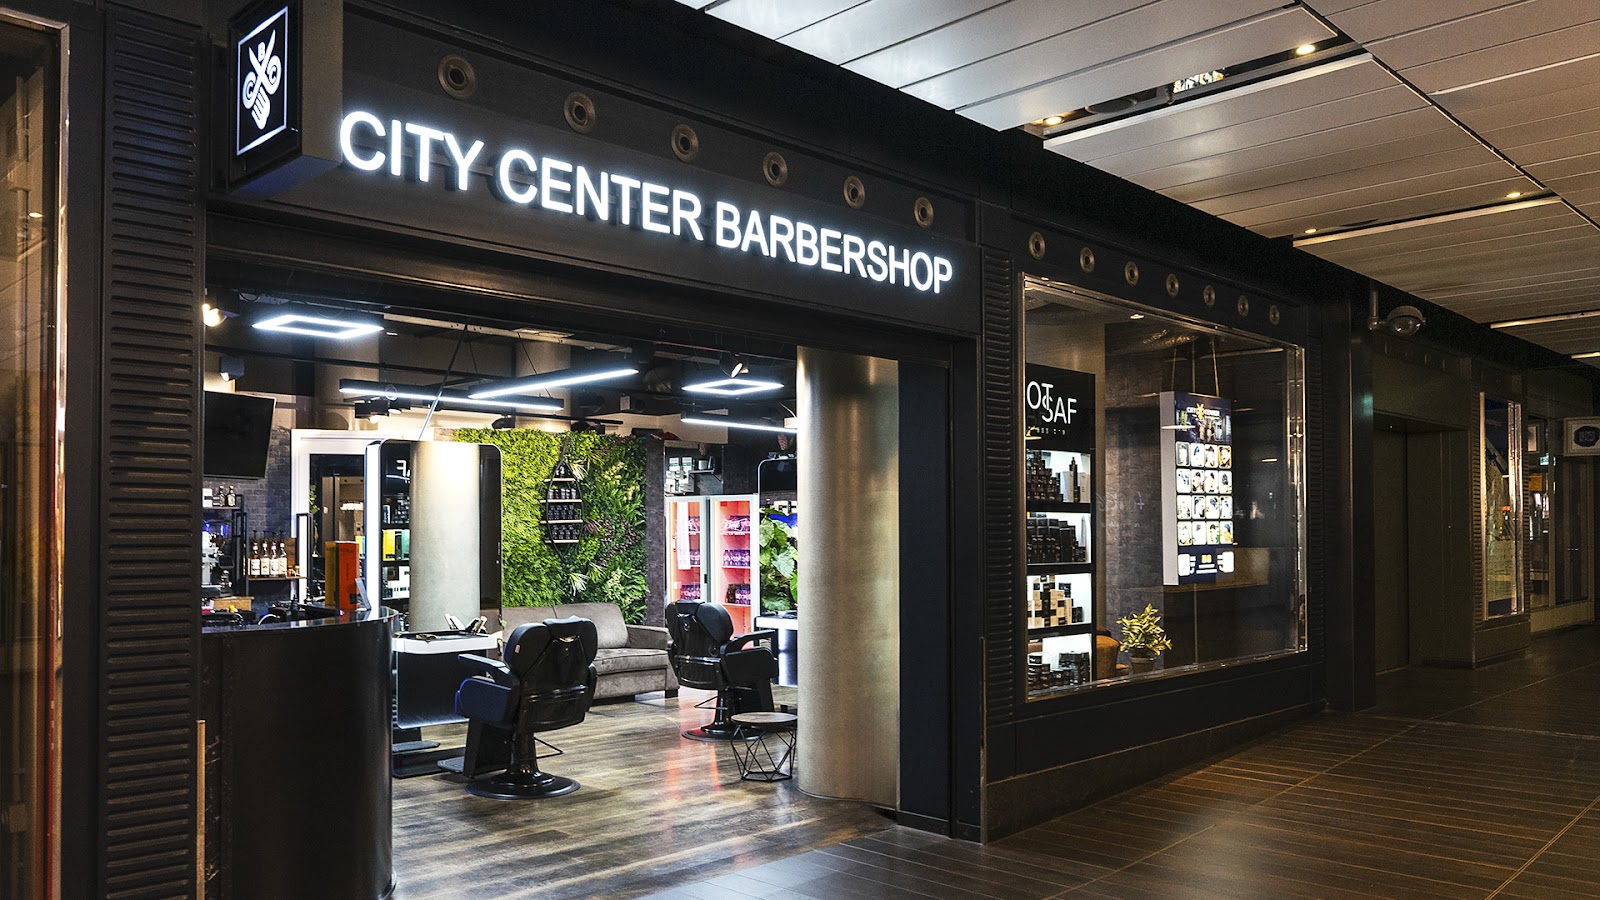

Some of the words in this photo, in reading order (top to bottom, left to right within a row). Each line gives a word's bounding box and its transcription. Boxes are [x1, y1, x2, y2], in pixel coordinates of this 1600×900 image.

[339, 110, 484, 191] CITY
[499, 148, 704, 240] CENTER
[716, 201, 953, 293] BARBERSHOP
